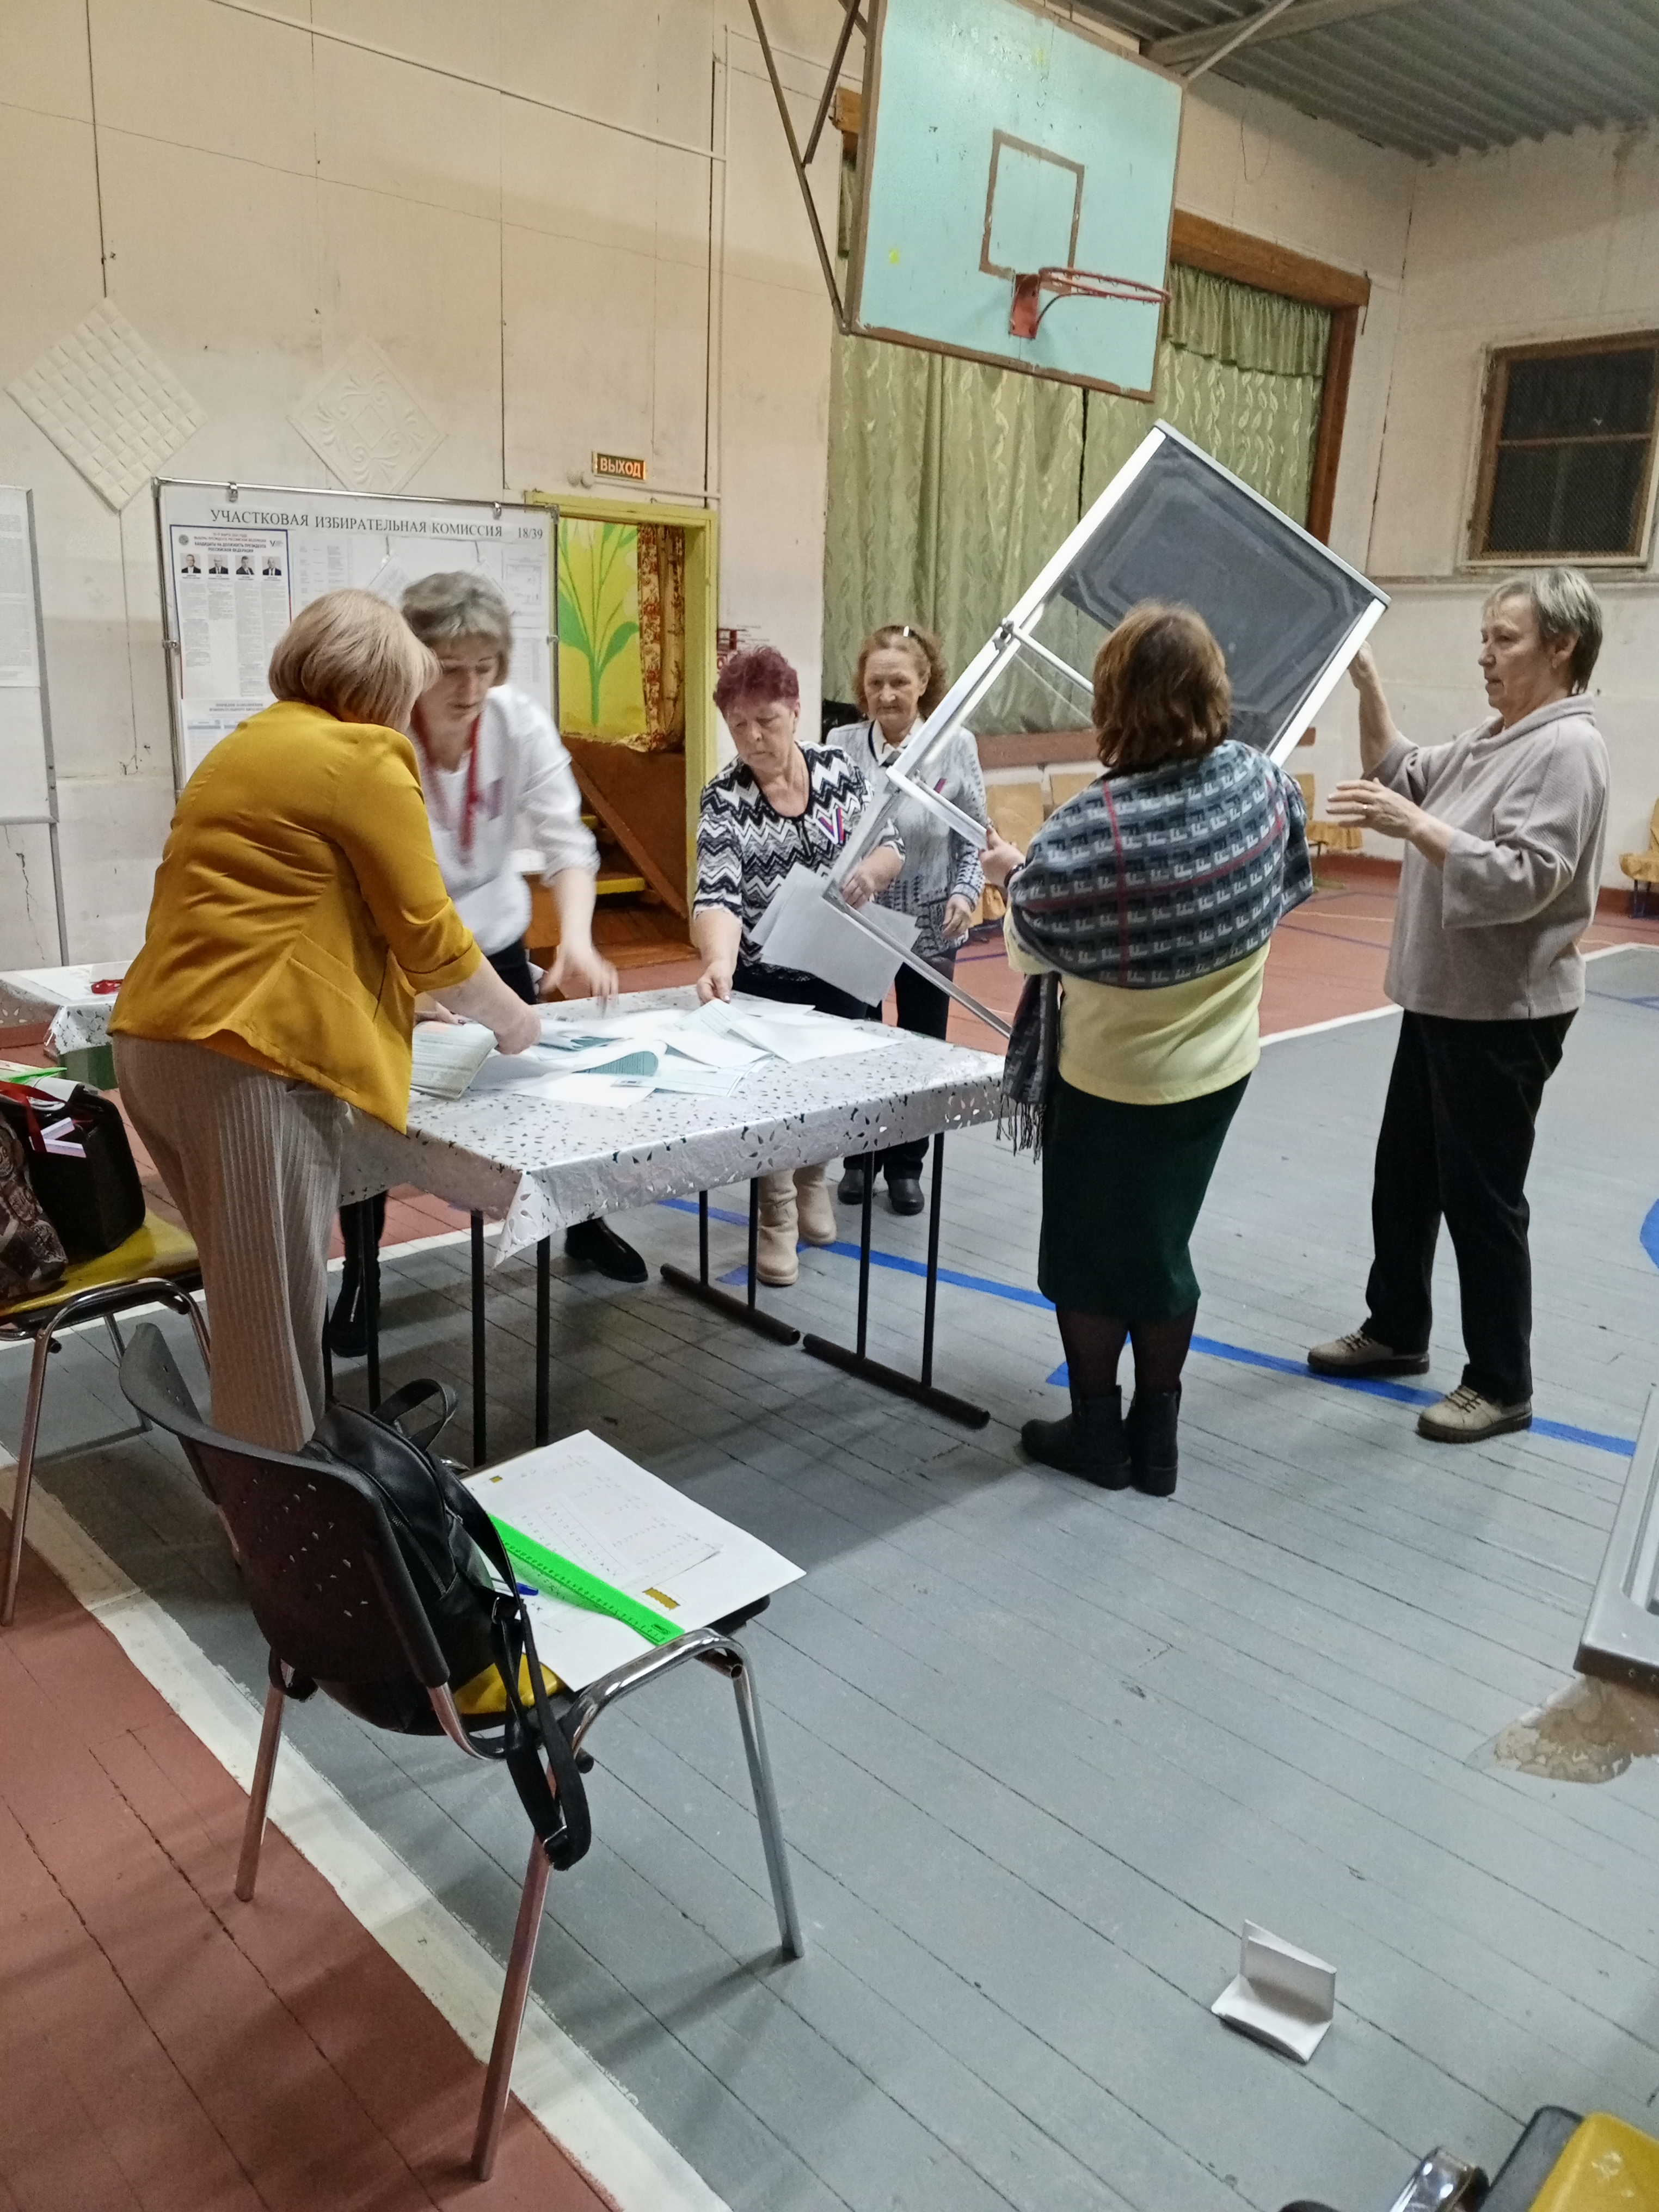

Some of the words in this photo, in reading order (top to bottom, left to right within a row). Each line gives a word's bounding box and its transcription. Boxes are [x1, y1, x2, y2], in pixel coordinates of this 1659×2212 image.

[600, 458, 641, 478] ВЫХОД
[211, 509, 309, 526] УЧАСТКОВАЯ
[315, 516, 426, 533] ИЗБИРАТЕЛЬНАЯ
[432, 521, 502, 537] КОМИССИЯ
[518, 527, 543, 539] 18/39
